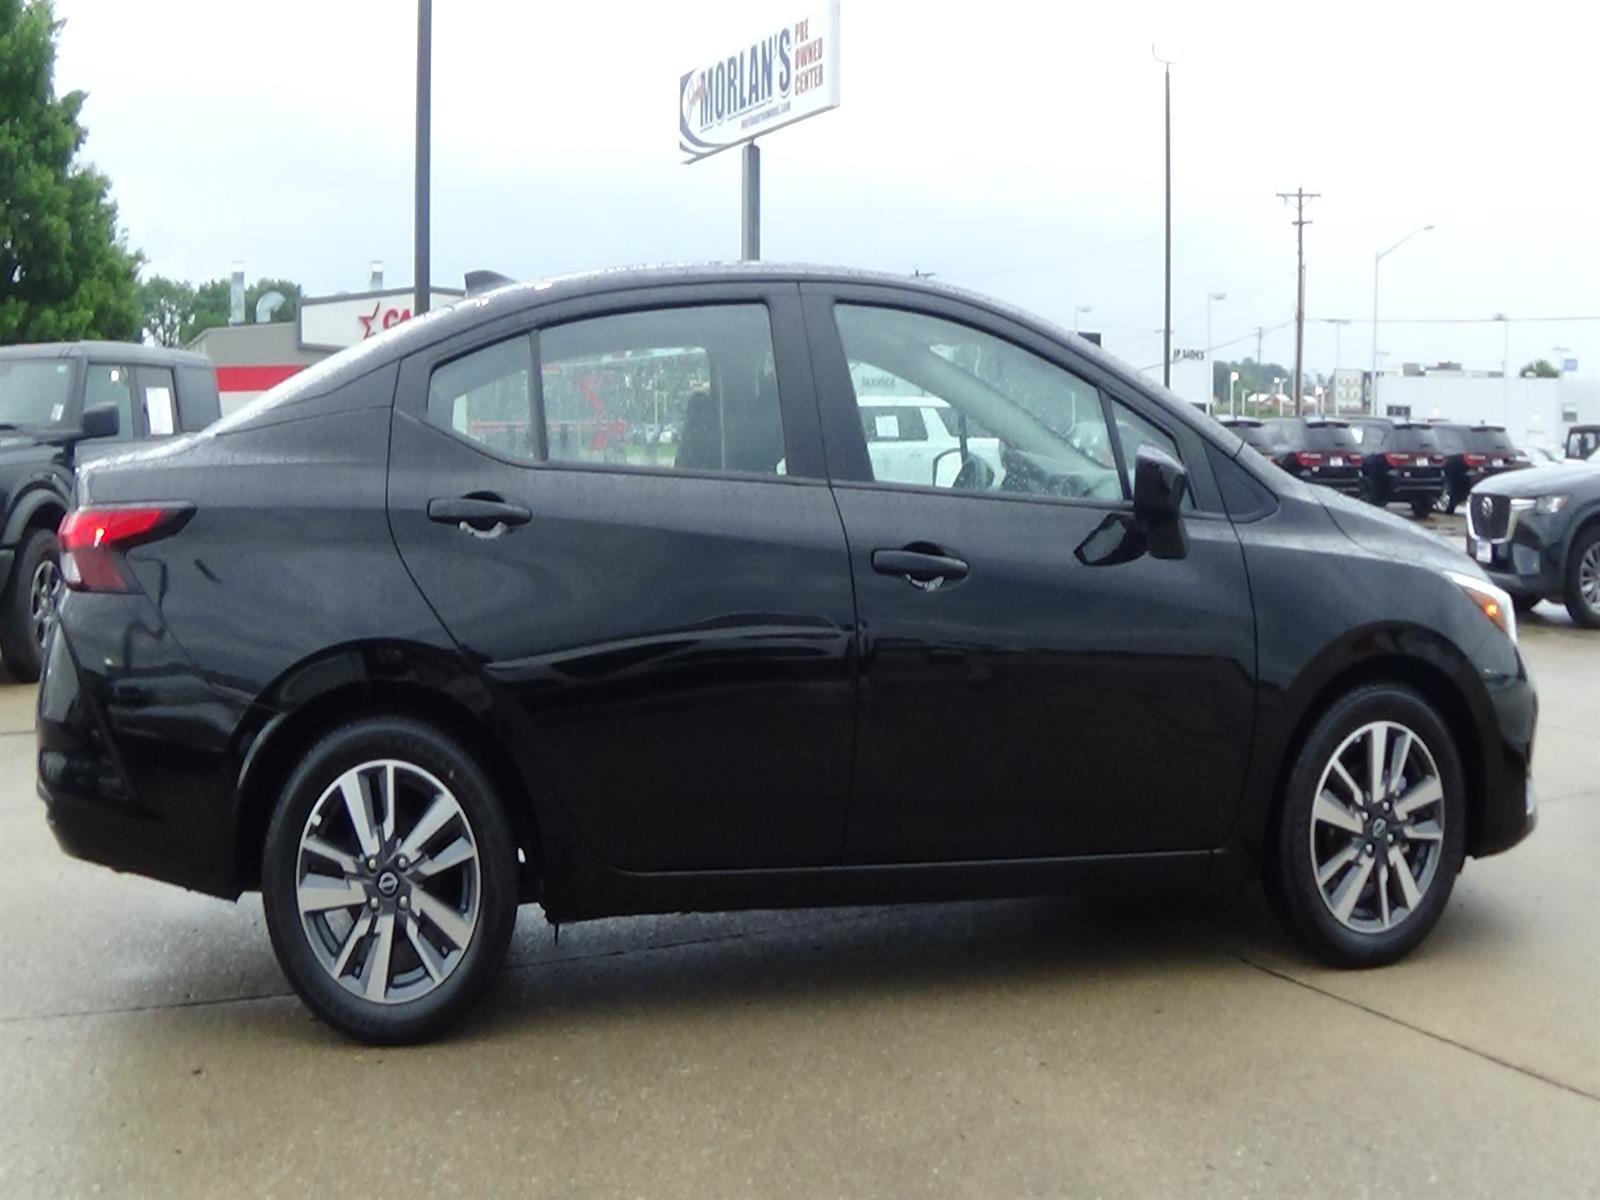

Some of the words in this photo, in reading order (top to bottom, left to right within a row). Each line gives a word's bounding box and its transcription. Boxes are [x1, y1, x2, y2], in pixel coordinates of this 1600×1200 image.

[795, 18, 808, 45] PRE
[795, 37, 823, 70] OWNED
[700, 28, 791, 127] MORLAN'S
[795, 63, 823, 96] CENTER
